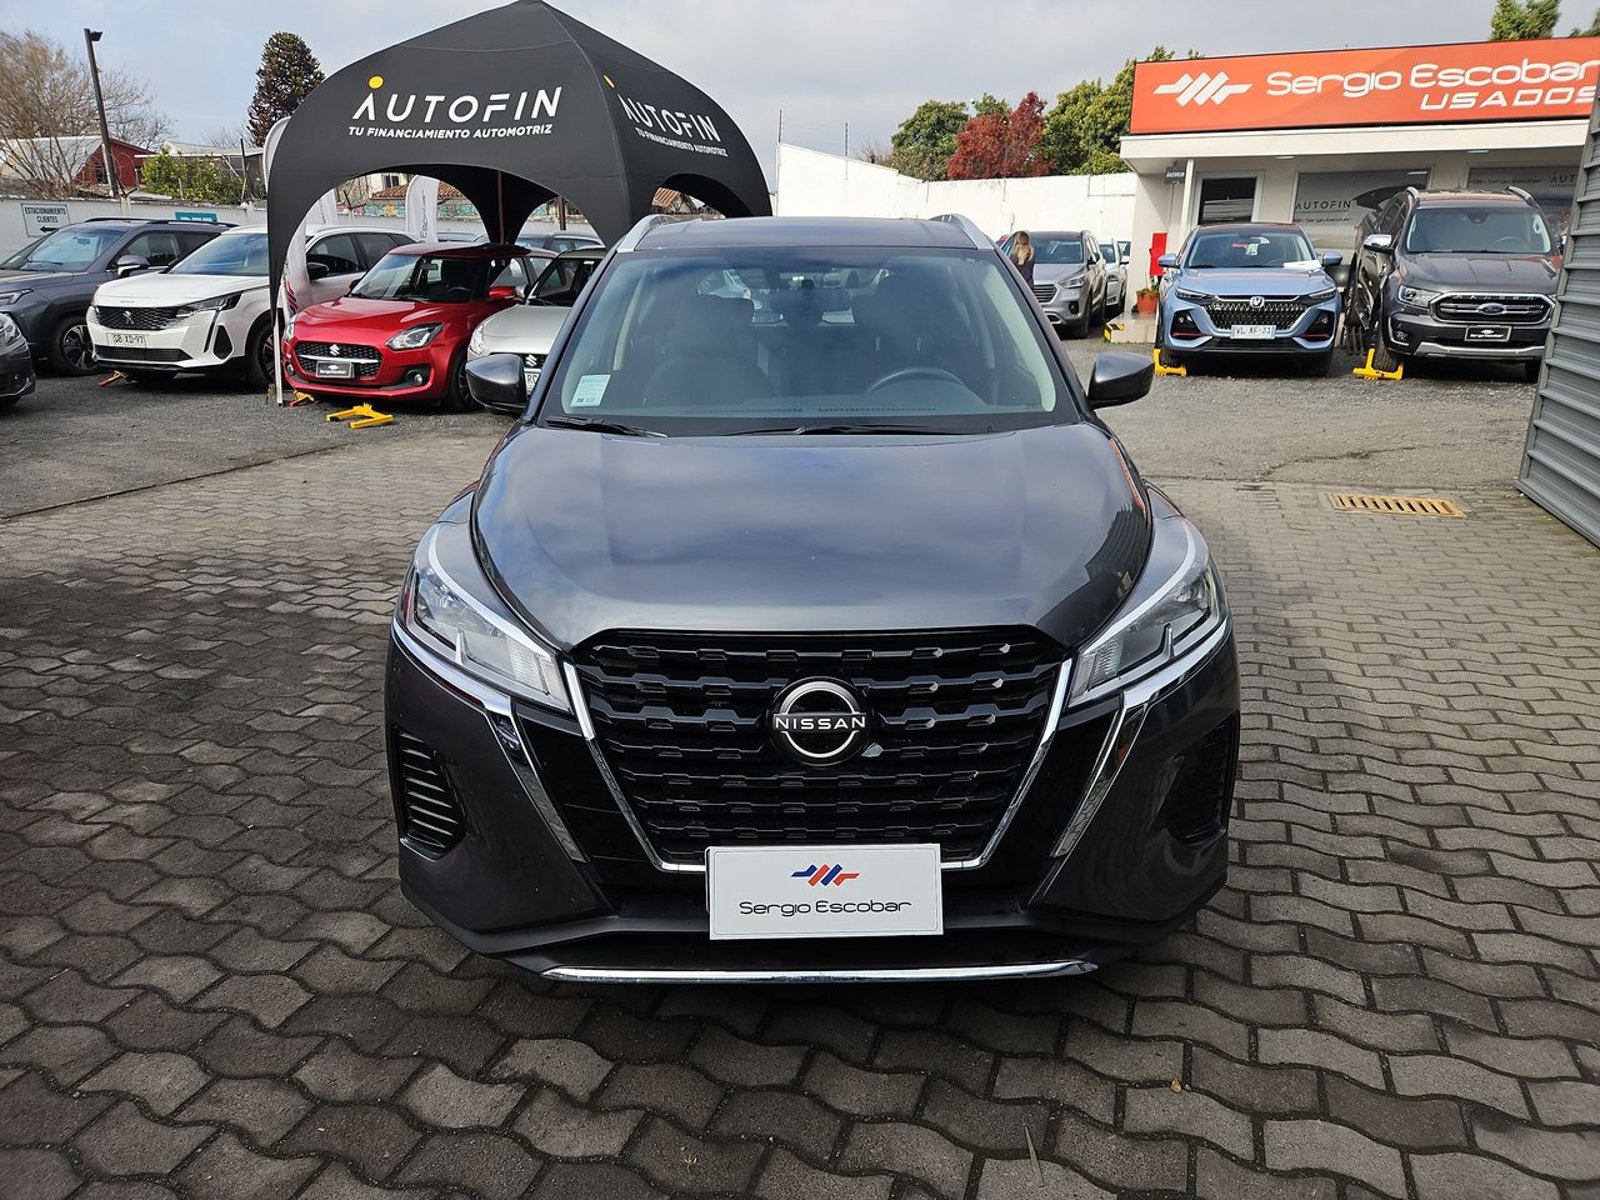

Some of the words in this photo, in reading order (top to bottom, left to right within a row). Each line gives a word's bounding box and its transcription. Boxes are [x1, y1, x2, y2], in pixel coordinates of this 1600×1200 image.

[1266, 70, 1402, 98] Sergio
[1409, 58, 1600, 89] Escobar
[352, 86, 562, 123] AUTOFIN
[1419, 85, 1597, 111] USADOS
[617, 93, 721, 142] AUTOFIN
[348, 126, 365, 137] TU
[367, 127, 471, 139] FINANCIAMIENTO
[473, 124, 553, 138] AUTOMOTRIZ
[24, 206, 67, 216] ESTACIONAMIENTO
[1295, 200, 1351, 210] AUTOFIN
[36, 215, 59, 223] CLIENTES
[775, 716, 866, 730] NISSAN
[739, 900, 811, 917] Sergio
[815, 899, 912, 914] Escobar
